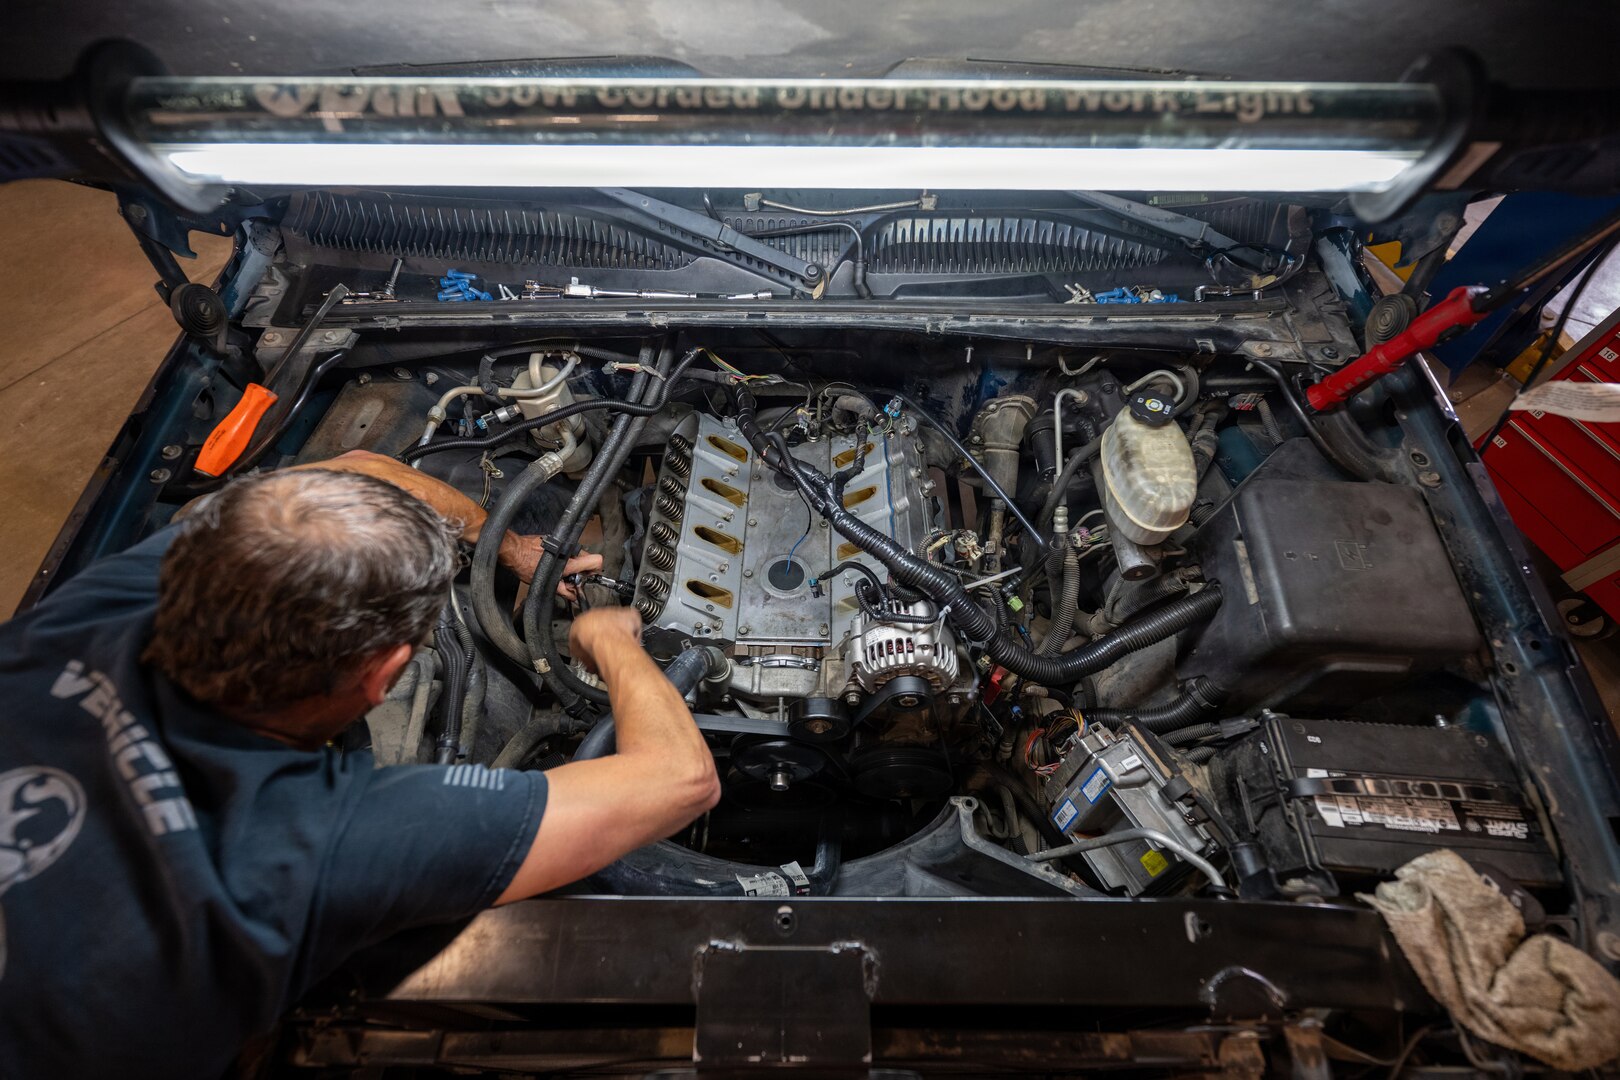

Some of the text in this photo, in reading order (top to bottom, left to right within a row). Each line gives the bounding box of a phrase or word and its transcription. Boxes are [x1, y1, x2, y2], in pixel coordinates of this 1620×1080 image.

[1063, 90, 1181, 113] Work
[1195, 90, 1315, 124] Light
[1603, 350, 1616, 360] 16
[50, 660, 198, 836] VEHICLE
